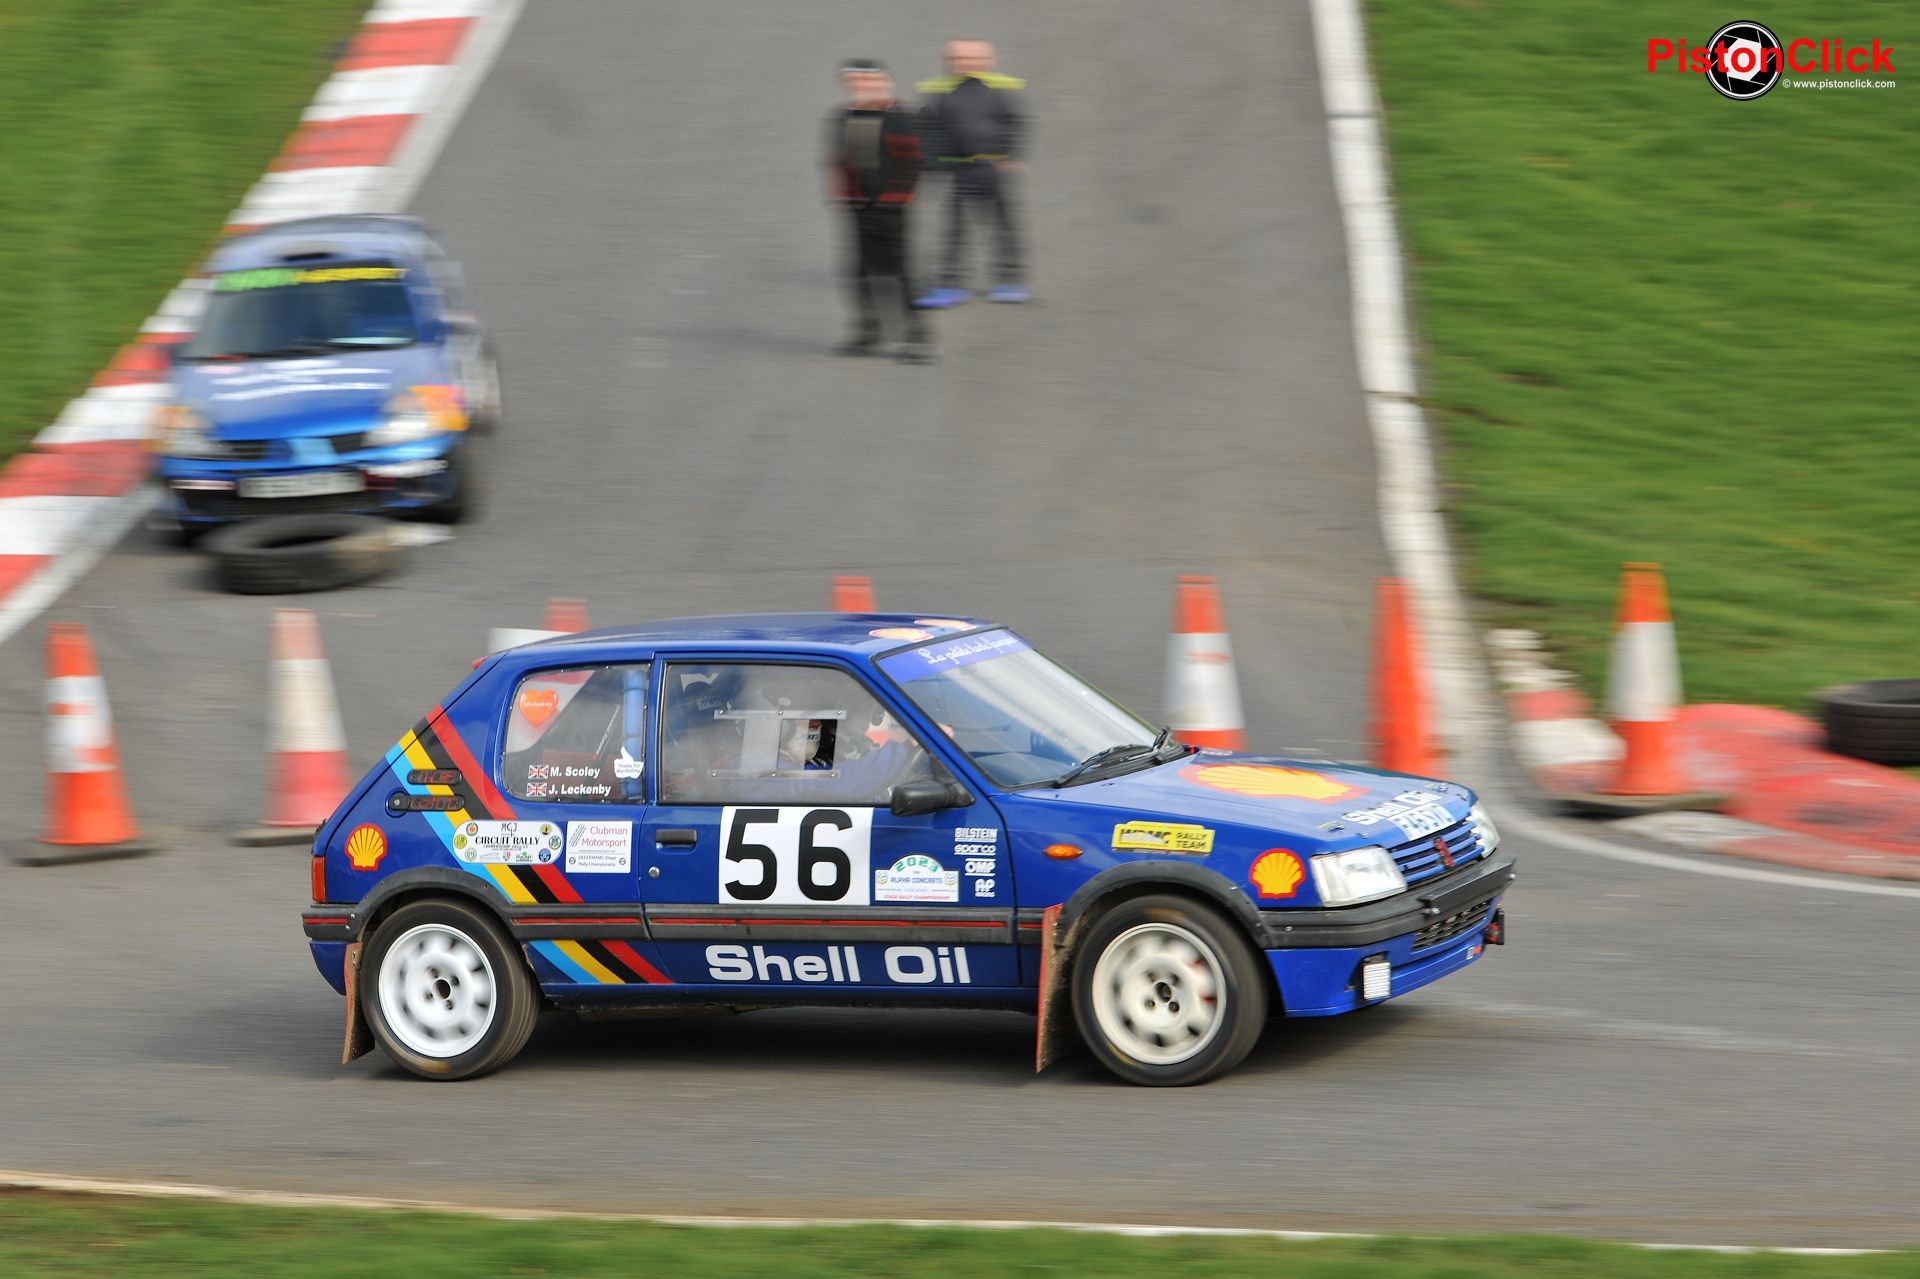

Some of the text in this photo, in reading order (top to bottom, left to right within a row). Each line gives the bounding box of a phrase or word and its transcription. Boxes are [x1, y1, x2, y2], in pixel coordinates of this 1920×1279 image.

[549, 766, 601, 779] M. Scoley
[548, 784, 611, 797] J. Leckenby
[590, 826, 628, 835] Clubman
[955, 827, 998, 838] BILSTEIN
[1176, 832, 1208, 840] RALLY
[475, 836, 540, 845] CIRCUIT RALLY
[582, 838, 626, 848] Motorsport
[1176, 841, 1206, 849] TEAM
[954, 844, 996, 853] sparco
[725, 808, 853, 902] 56
[895, 857, 940, 872] 2023
[965, 860, 996, 874] OMP
[705, 945, 971, 984] Shell Oil
